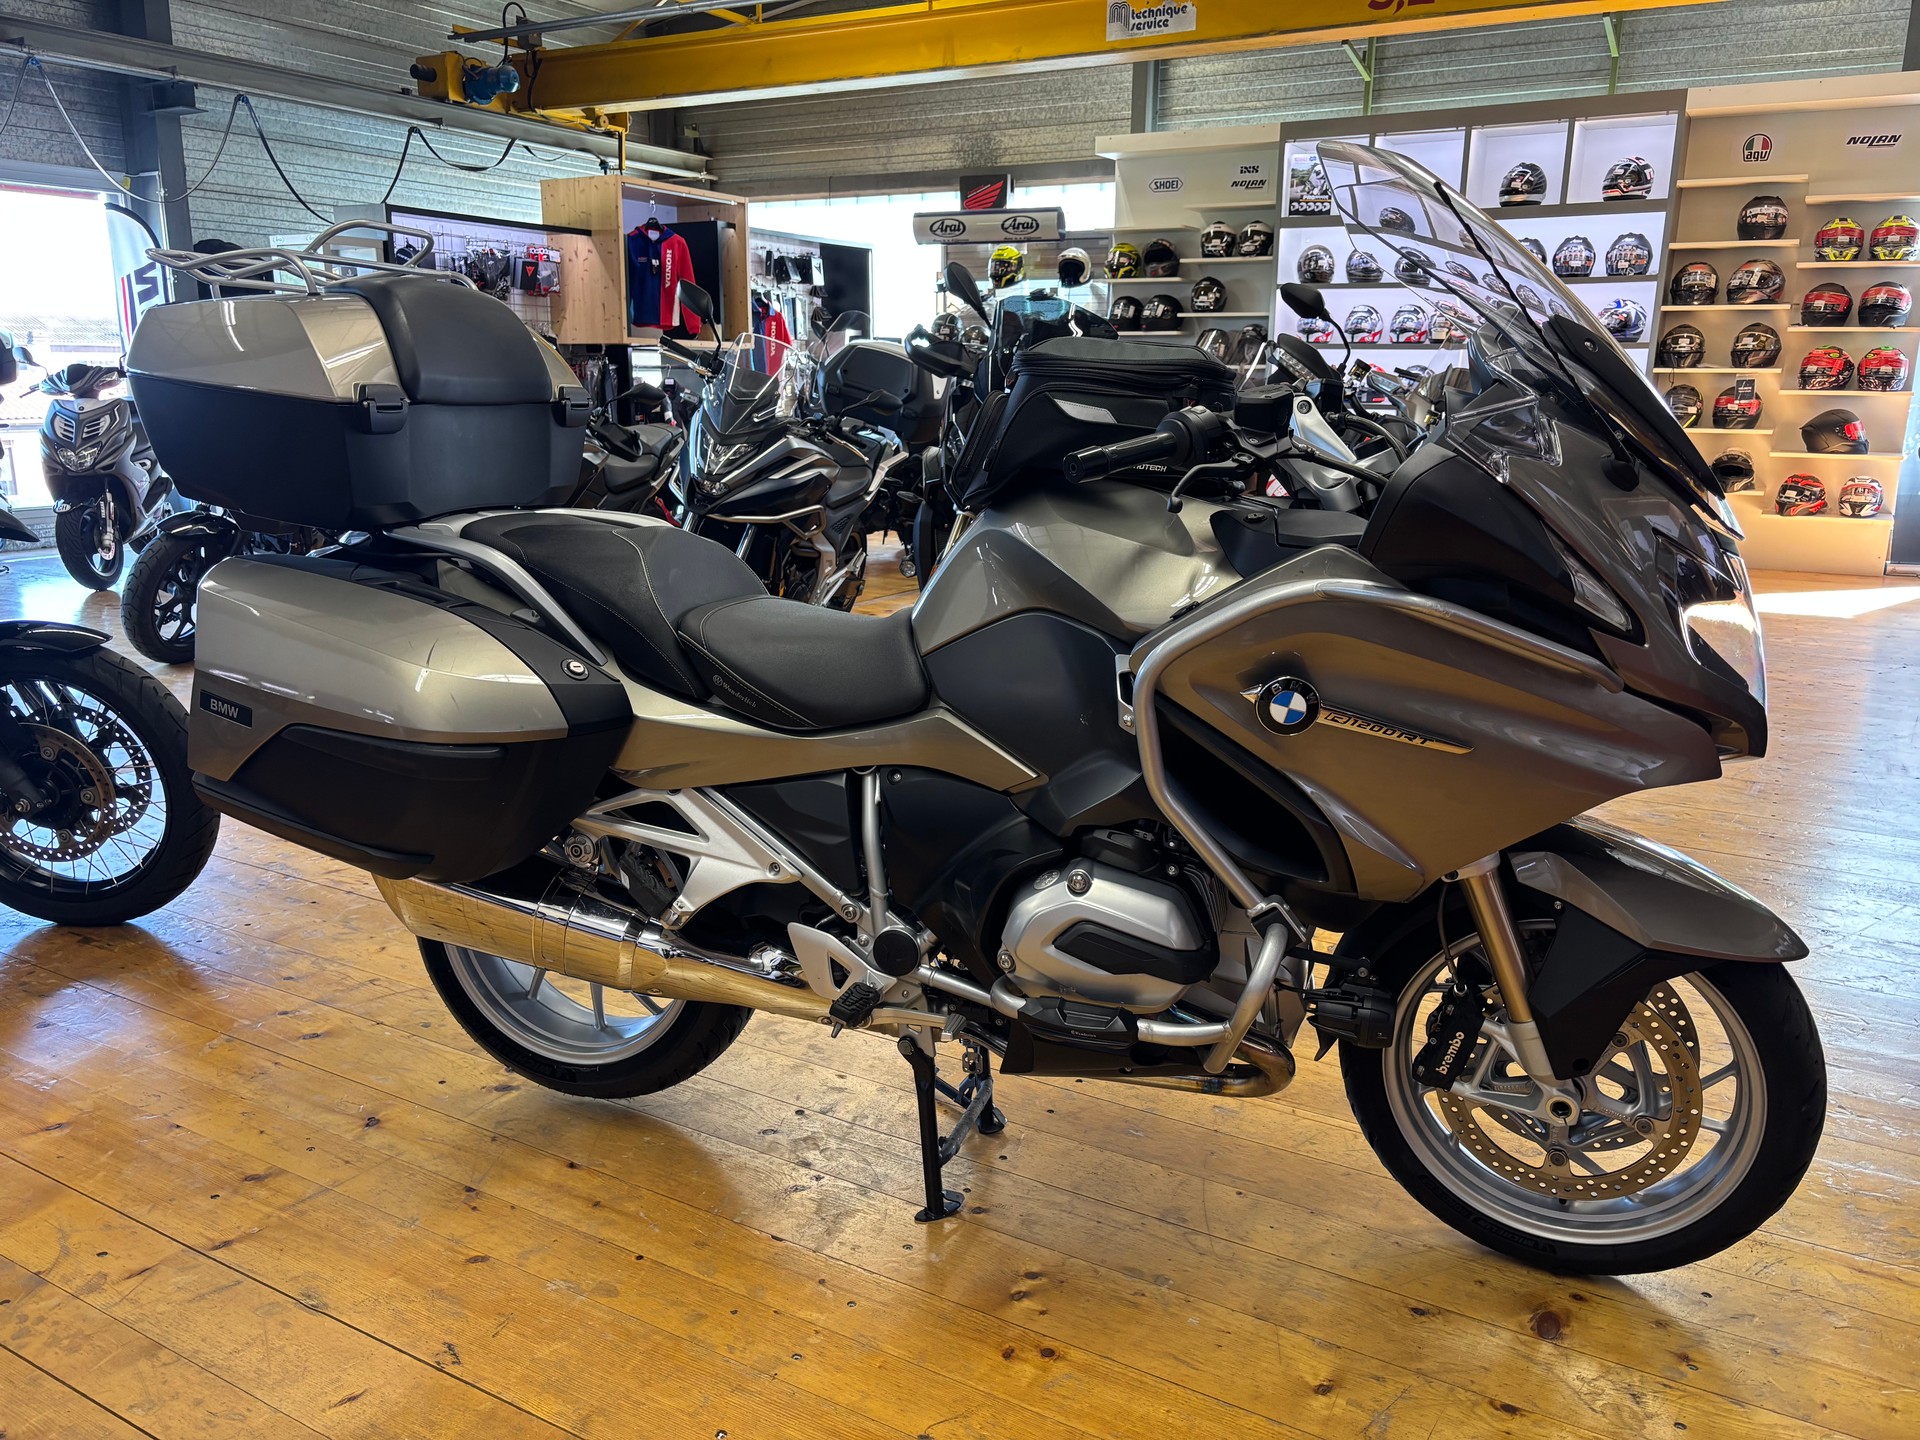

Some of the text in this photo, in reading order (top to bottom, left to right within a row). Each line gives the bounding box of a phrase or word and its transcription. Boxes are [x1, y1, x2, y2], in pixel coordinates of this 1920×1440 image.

[1131, 5, 1188, 20] technique
[1130, 18, 1169, 31] service
[1846, 134, 1902, 148] NOLAN
[1153, 180, 1179, 190] SHOEI
[1231, 179, 1267, 190] NOLAN
[933, 216, 1034, 233] Arai Arai
[665, 249, 673, 288] HONDA
[722, 682, 757, 708] Wunderlich
[1271, 680, 1318, 705] BMW
[210, 698, 239, 718] BMW
[1435, 1032, 1465, 1075] brembo
